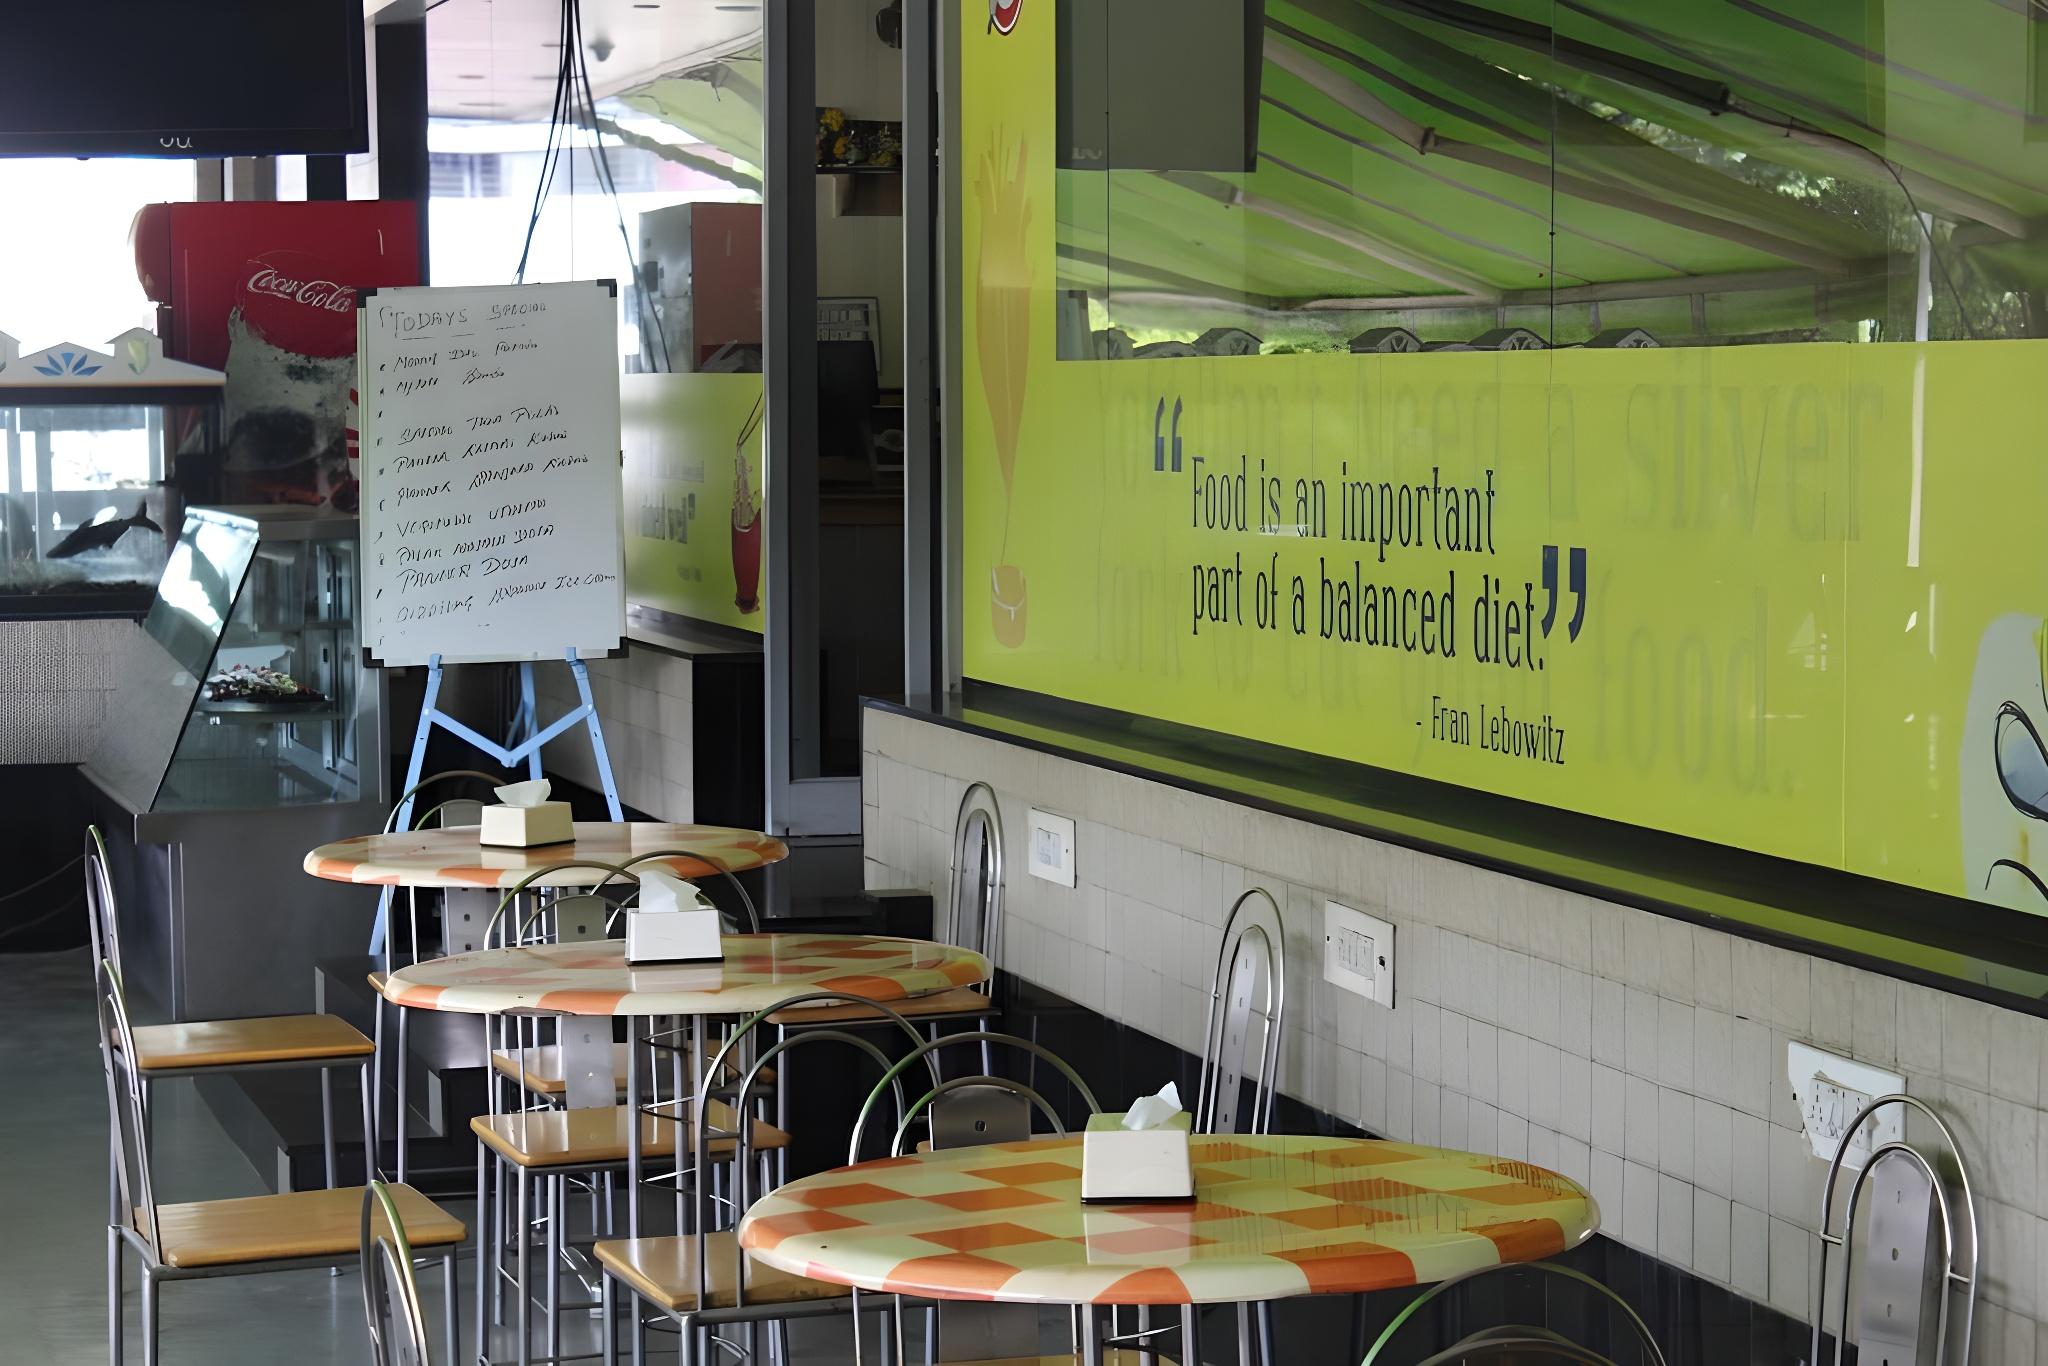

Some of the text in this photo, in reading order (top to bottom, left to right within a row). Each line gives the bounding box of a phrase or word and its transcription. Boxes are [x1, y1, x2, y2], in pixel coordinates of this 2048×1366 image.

[1192, 455, 1496, 562] Food is an important
[1192, 552, 1243, 635] part
[1256, 552, 1279, 630] of
[1292, 575, 1306, 635] a
[1320, 556, 1457, 659] balanced
[1432, 696, 1470, 746] Fran
[1480, 704, 1565, 765] Lebowitz
